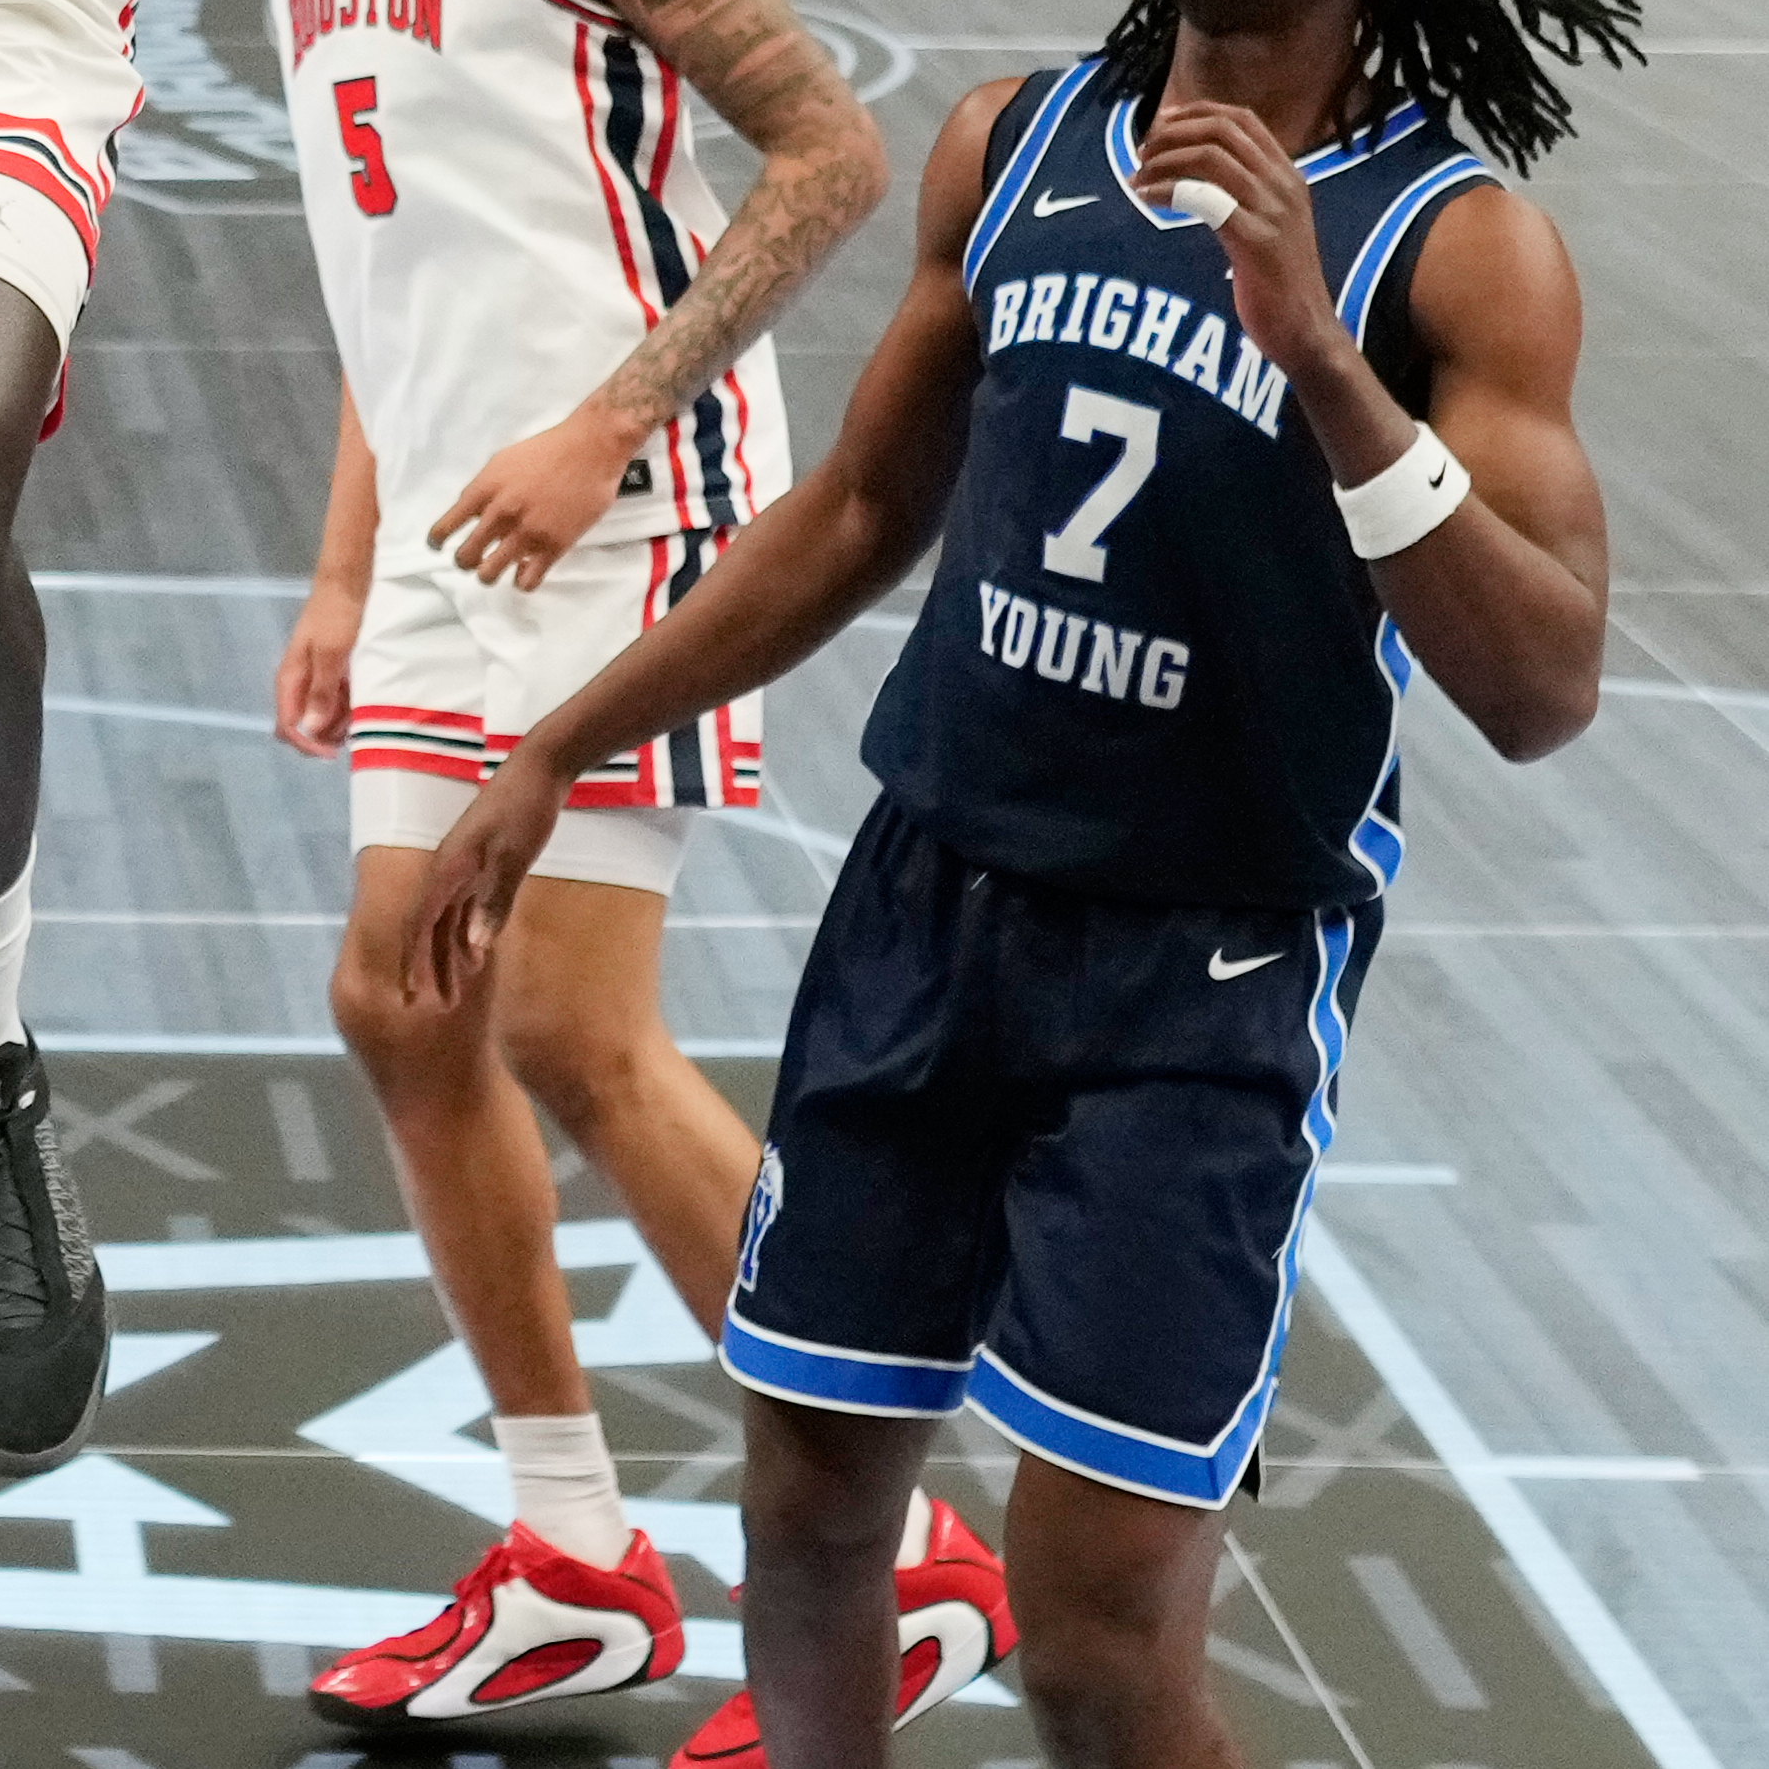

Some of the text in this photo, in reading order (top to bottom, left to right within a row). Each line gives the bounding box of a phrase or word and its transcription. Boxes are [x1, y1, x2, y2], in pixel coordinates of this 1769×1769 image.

[333, 75, 398, 216] 5
[988, 273, 1289, 439] BRIGHAM
[1043, 384, 1161, 584] 7
[978, 581, 1190, 710] YOUNG
